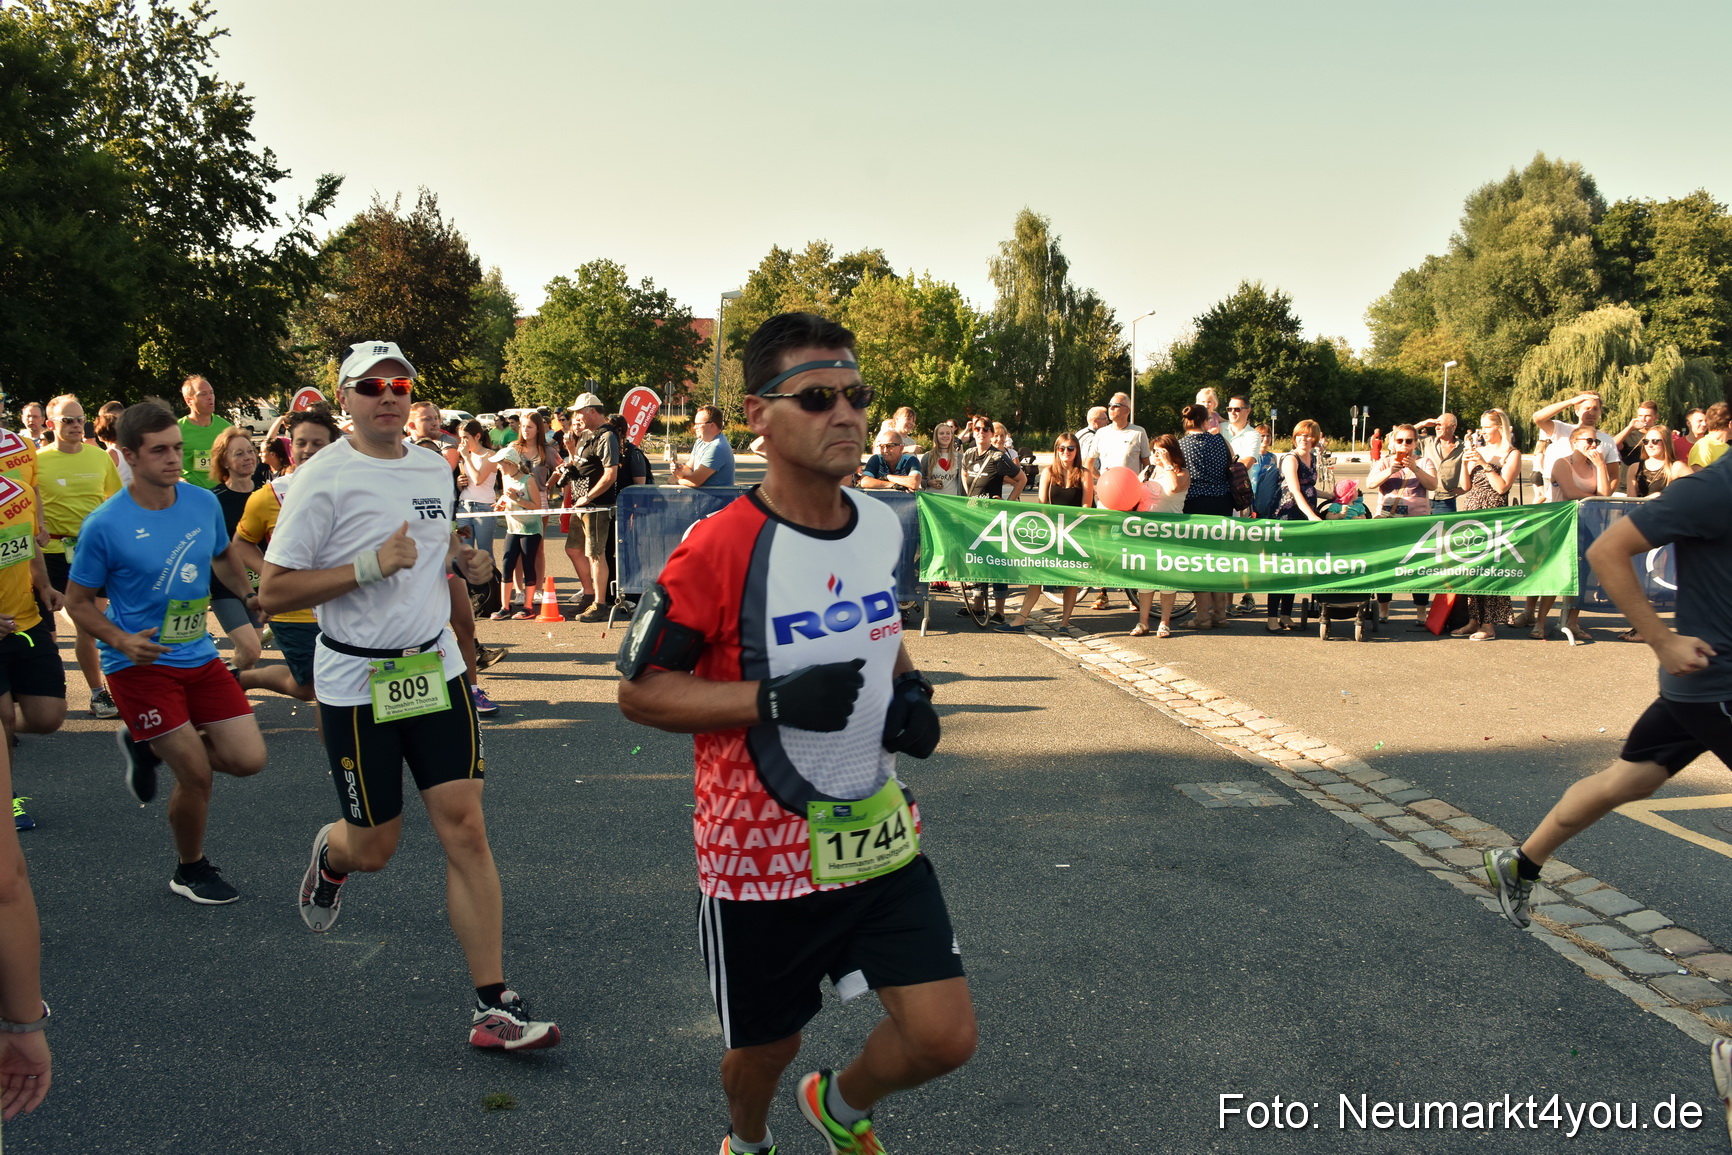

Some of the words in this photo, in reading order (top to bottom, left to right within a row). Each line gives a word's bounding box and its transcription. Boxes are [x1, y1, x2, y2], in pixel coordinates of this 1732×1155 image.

[5, 454, 33, 469] BÖGL
[3, 497, 32, 520] BÖGL
[969, 510, 1108, 558] AOK
[1122, 516, 1284, 542] Gesundheit
[1399, 519, 1528, 564] AOK
[152, 567, 170, 592] Team
[166, 540, 187, 566] Schick
[184, 527, 202, 541] Bau
[965, 553, 984, 564] Die
[986, 555, 1092, 568] Gesundheitskasse.
[1122, 547, 1146, 571] in
[1157, 549, 1249, 573] besten
[1259, 552, 1367, 575] Händen
[1395, 567, 1414, 576] Die
[1417, 565, 1526, 577] Gesundheitskasse.
[389, 676, 429, 702] 809
[416, 697, 438, 706] Thomas
[138, 708, 162, 729] 25
[344, 770, 362, 819] SKINS
[827, 811, 906, 861] 1744
[829, 859, 875, 870] Herrmann
